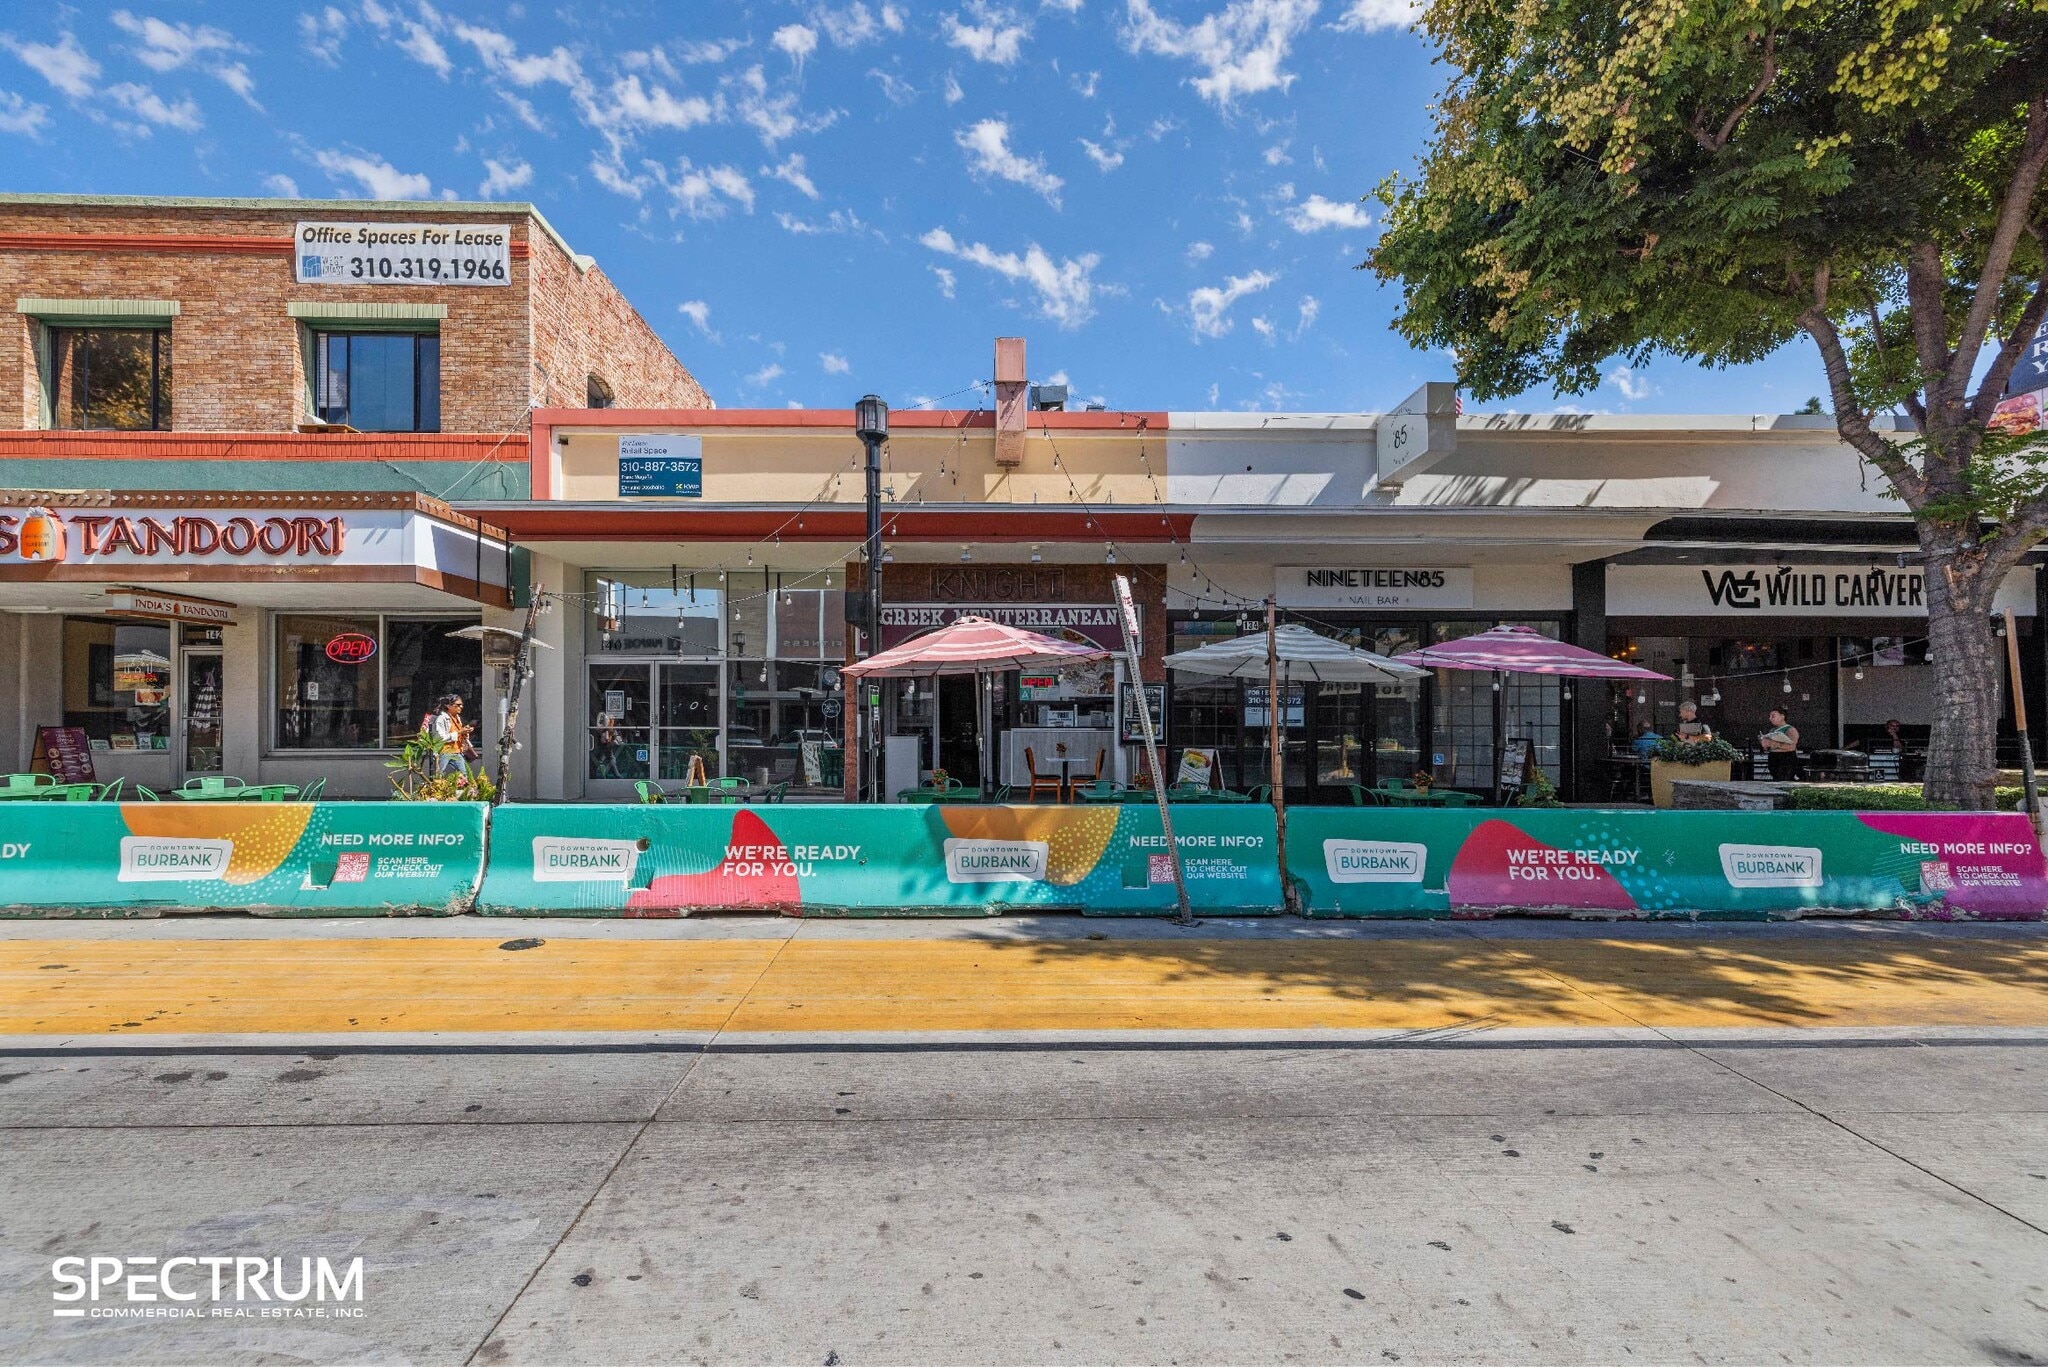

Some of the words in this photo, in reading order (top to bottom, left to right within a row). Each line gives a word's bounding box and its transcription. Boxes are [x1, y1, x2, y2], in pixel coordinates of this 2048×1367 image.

[303, 227, 351, 243] Office
[357, 228, 416, 247] Spaces
[422, 230, 449, 245] For
[455, 230, 503, 246] Lease
[350, 257, 505, 280] 310.319.1966
[643, 447, 668, 455] Space
[621, 461, 699, 472] 310-887-3572
[68, 515, 345, 556] TANDOORI
[935, 571, 1062, 598] KNIGHT
[1307, 570, 1445, 587] NINETEEN85
[1765, 574, 1825, 606] WILD
[1835, 574, 1928, 606] CARVER
[1349, 596, 1374, 605] NAIL
[1377, 596, 1399, 605] BAR
[135, 598, 172, 612] INDIA'S
[183, 605, 228, 619] TANDOORI
[880, 608, 945, 625] GREEK
[1243, 621, 1259, 630] 134
[328, 641, 373, 656] OPEN
[1021, 677, 1053, 688] OPEN
[321, 834, 364, 845] NEED
[369, 834, 414, 846] MORE
[418, 834, 464, 846] INFO?
[1130, 836, 1168, 848] NEED
[1174, 836, 1217, 848] MORE
[1221, 836, 1264, 848] INFO?
[724, 845, 788, 860] WE'RE
[794, 845, 862, 860] READY
[1900, 842, 1939, 855] NEED
[1944, 842, 1986, 855] MORE
[1990, 842, 2032, 855] INFO?
[137, 853, 212, 866] BURBANK
[550, 853, 621, 868] BURBANK
[961, 855, 1030, 869] BURBANK
[1185, 858, 1208, 866] SCAN
[1341, 856, 1411, 870] BURBANK
[1507, 849, 1569, 864] WE'RE
[1575, 849, 1639, 864] READY
[723, 862, 765, 877] FOR
[770, 862, 817, 877] YOU.
[1199, 865, 1226, 873] CHECK
[1228, 865, 1247, 873] OUT
[1509, 866, 1550, 881] FOR
[1555, 866, 1601, 881] YOU.
[1737, 860, 1806, 874] BURBANK
[1981, 879, 2022, 887] WEBSITE!
